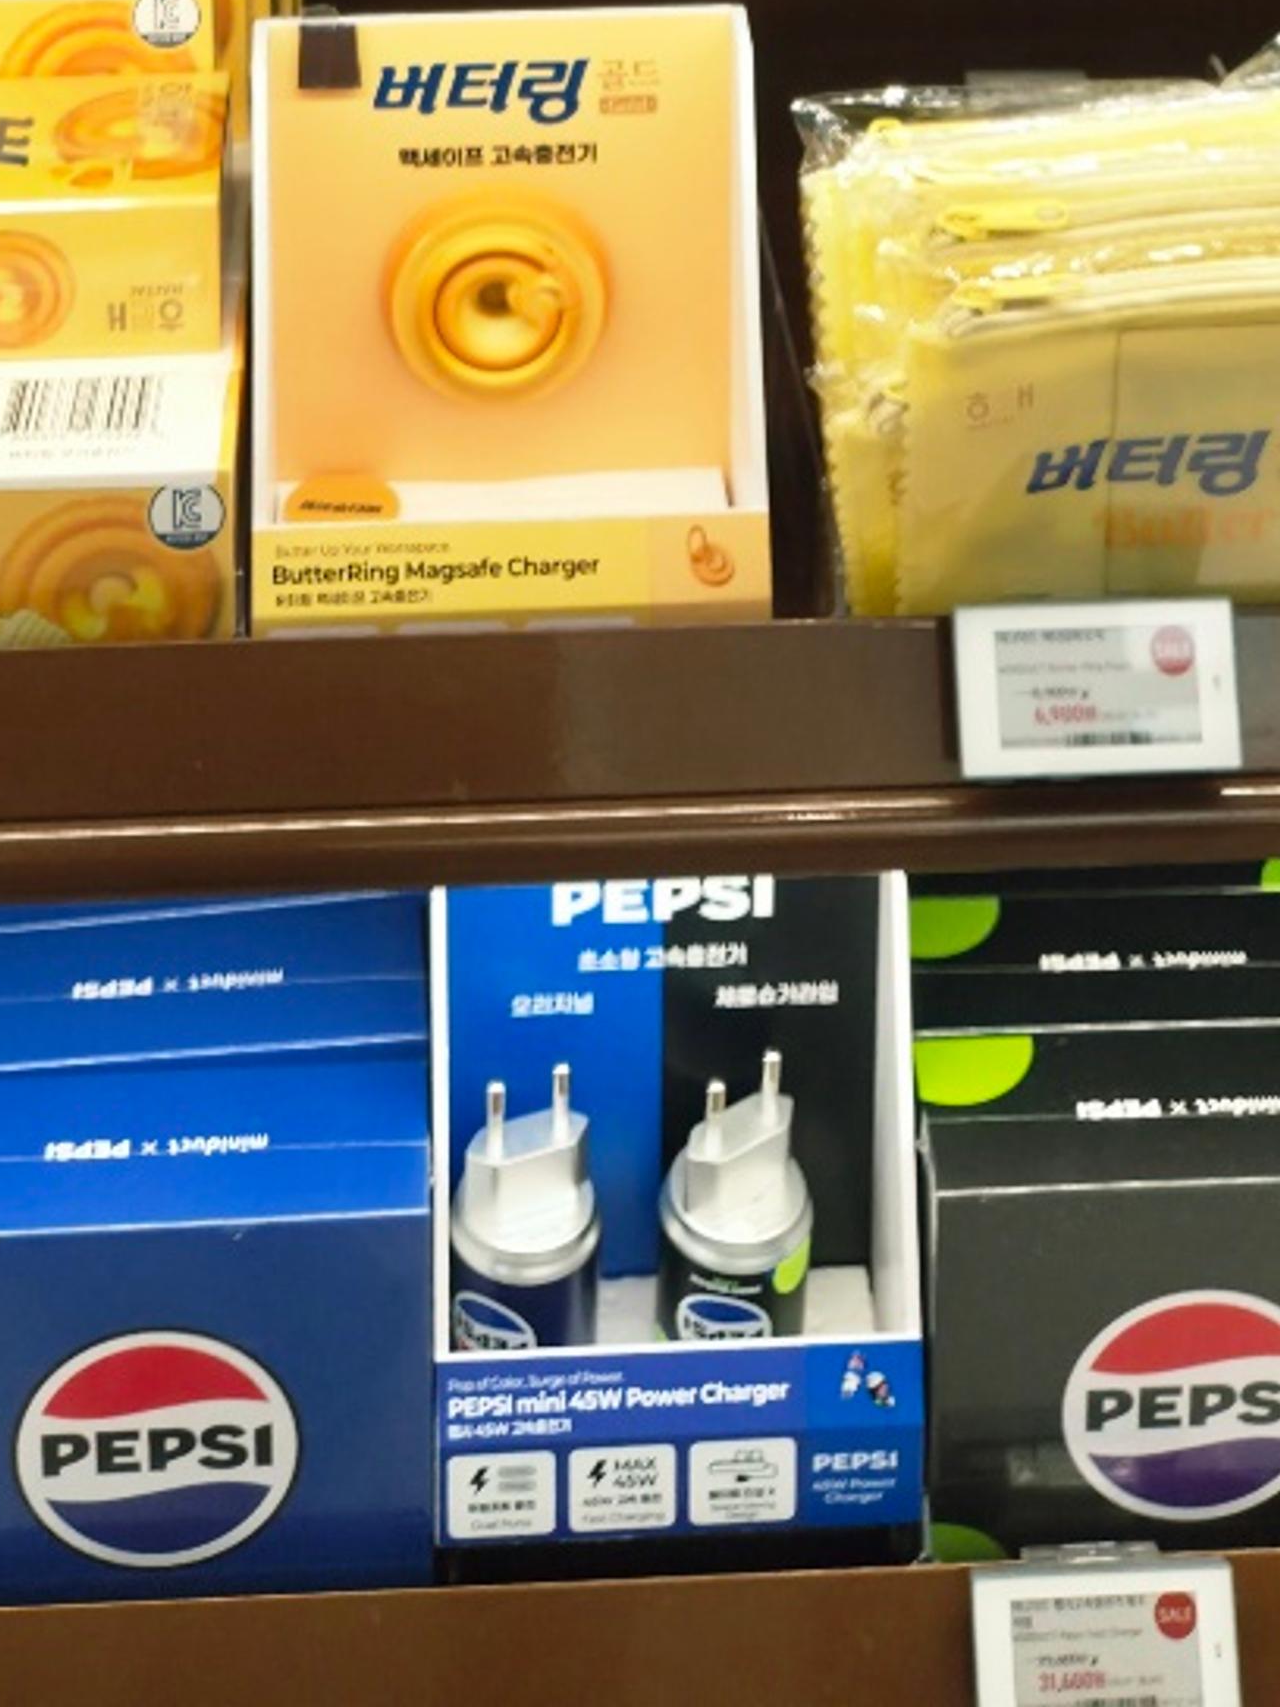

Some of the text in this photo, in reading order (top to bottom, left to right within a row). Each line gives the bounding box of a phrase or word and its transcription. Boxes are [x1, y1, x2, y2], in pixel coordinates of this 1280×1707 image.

[374, 59, 589, 124] 버터링
[398, 142, 598, 169] 맥세이프 고속충전기
[1023, 428, 1272, 497] 버터링
[271, 555, 600, 589] ButterRing Magsafe Charger
[551, 875, 775, 926] PEPSI
[645, 943, 748, 969] 고속충전기
[71, 974, 153, 1001] PEPSI
[43, 1131, 270, 1163] miniduct PEPSI
[448, 1383, 790, 1420] PEPSI mini 45W Power Charger
[40, 1422, 275, 1477] PEPSI
[811, 1450, 898, 1472] PEPSI
